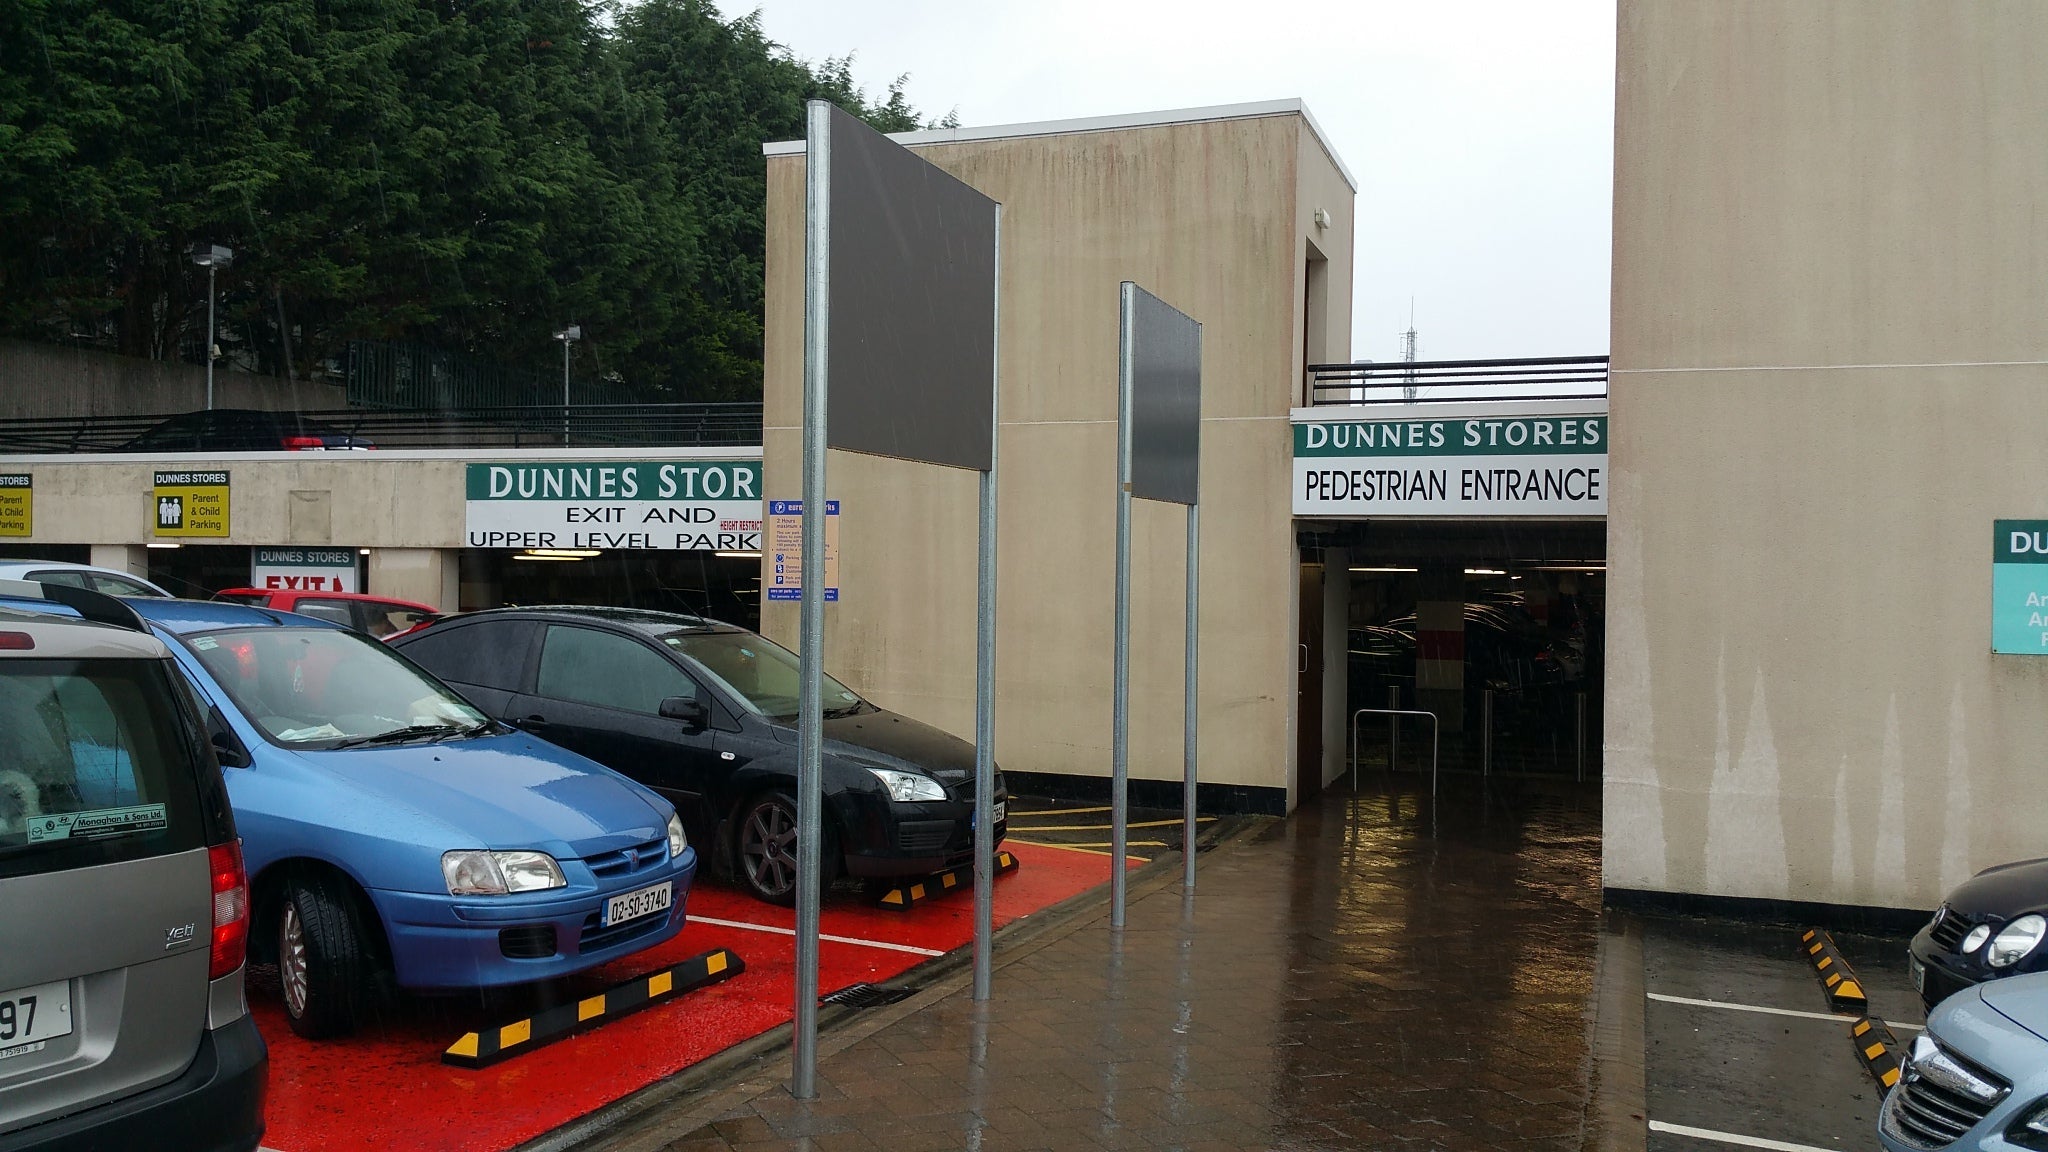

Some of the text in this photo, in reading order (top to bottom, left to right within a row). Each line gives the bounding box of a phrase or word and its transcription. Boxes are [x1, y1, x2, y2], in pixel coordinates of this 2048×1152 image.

[1306, 420, 1600, 449] DUNNES STORES
[156, 473, 227, 483] DUNNES STORES
[488, 464, 763, 498] DUNNES STOR
[1306, 468, 1600, 500] PEDESTRIAN ENTRANCE
[192, 493, 219, 503] Parent
[4, 507, 24, 517] Child
[191, 506, 220, 516] & Child
[566, 507, 716, 524] EXIT AND
[190, 519, 221, 531] Parking
[720, 520, 739, 531] HEIGHT
[470, 531, 763, 550] UPPER LEVEL PARK
[260, 550, 350, 563] DUNNES STORES
[266, 575, 325, 591] EXIT
[78, 817, 122, 828] Monaghan
[132, 813, 149, 821] Sons
[612, 888, 667, 922] 02-SO-3740
